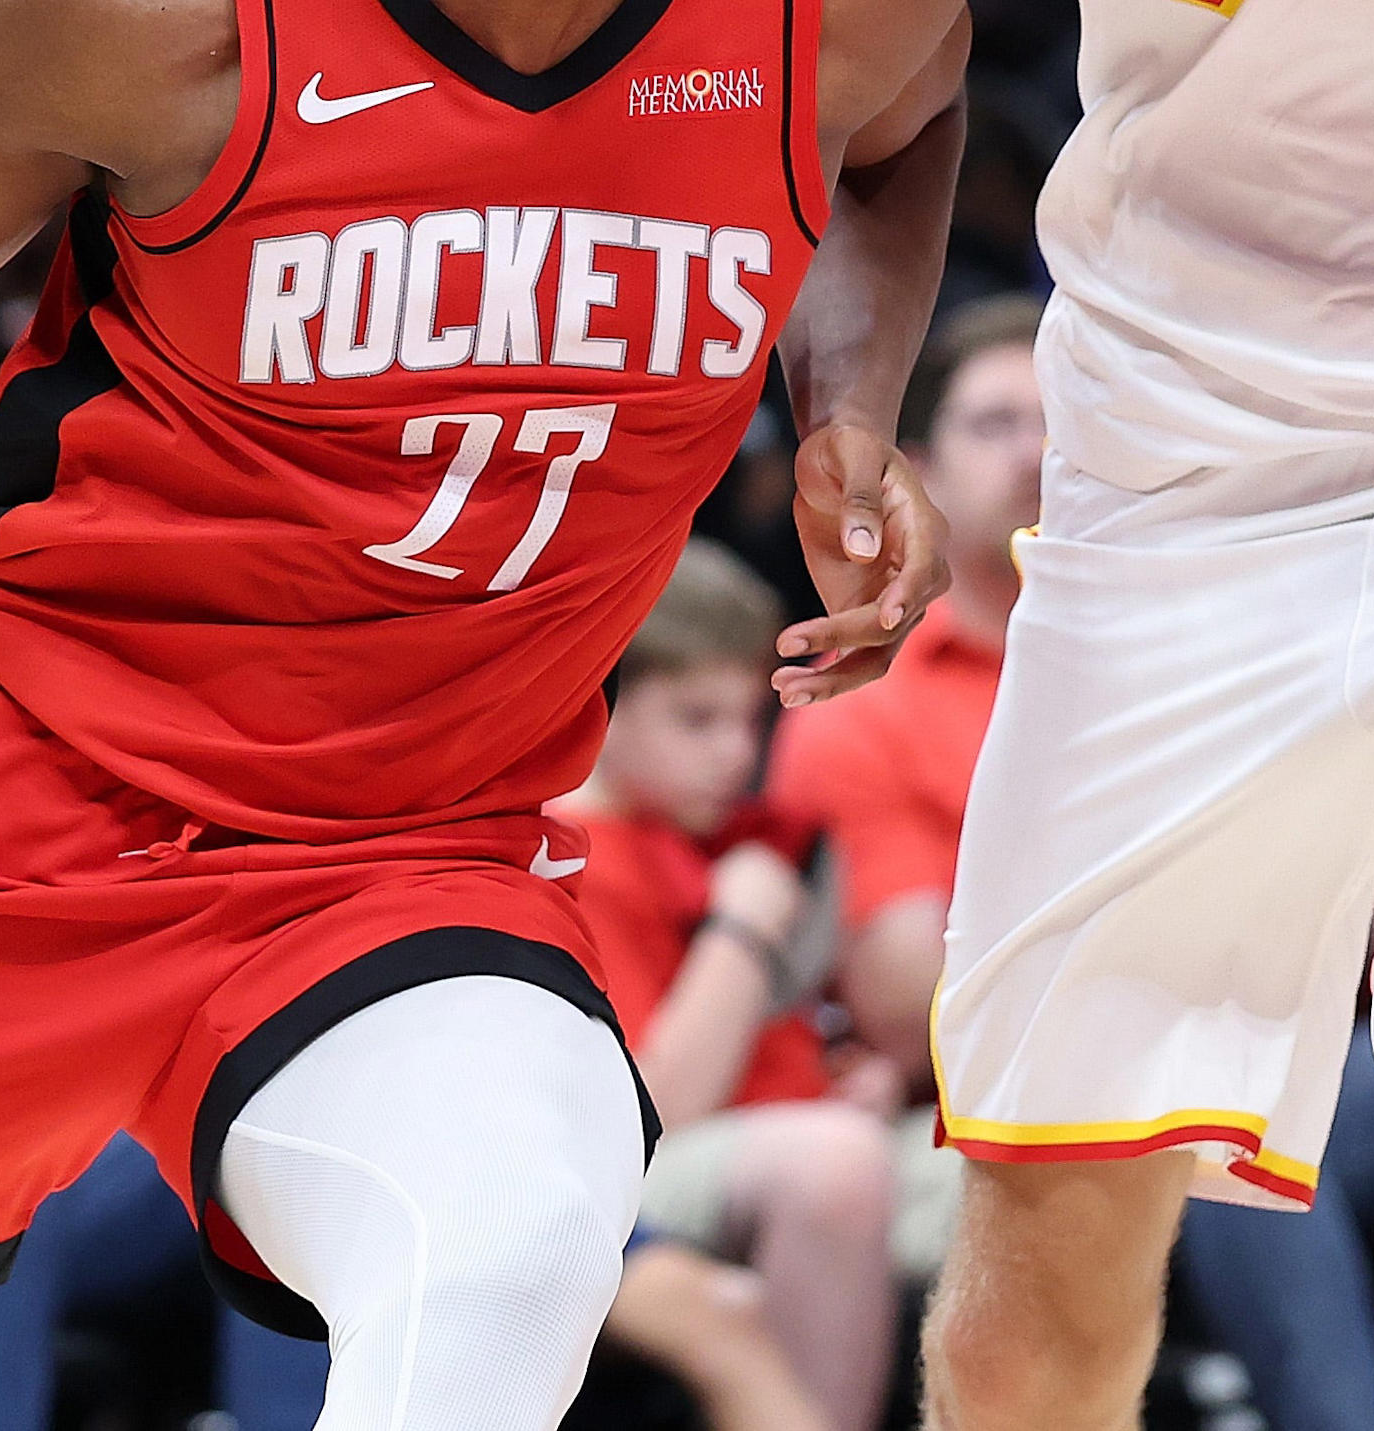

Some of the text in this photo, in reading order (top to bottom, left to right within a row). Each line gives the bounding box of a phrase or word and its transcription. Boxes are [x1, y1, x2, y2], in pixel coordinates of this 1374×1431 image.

[628, 87, 764, 117] HERMANN
[629, 67, 765, 99] MEMORIAL
[238, 205, 772, 385] ROCKETS
[362, 404, 617, 592] 27
